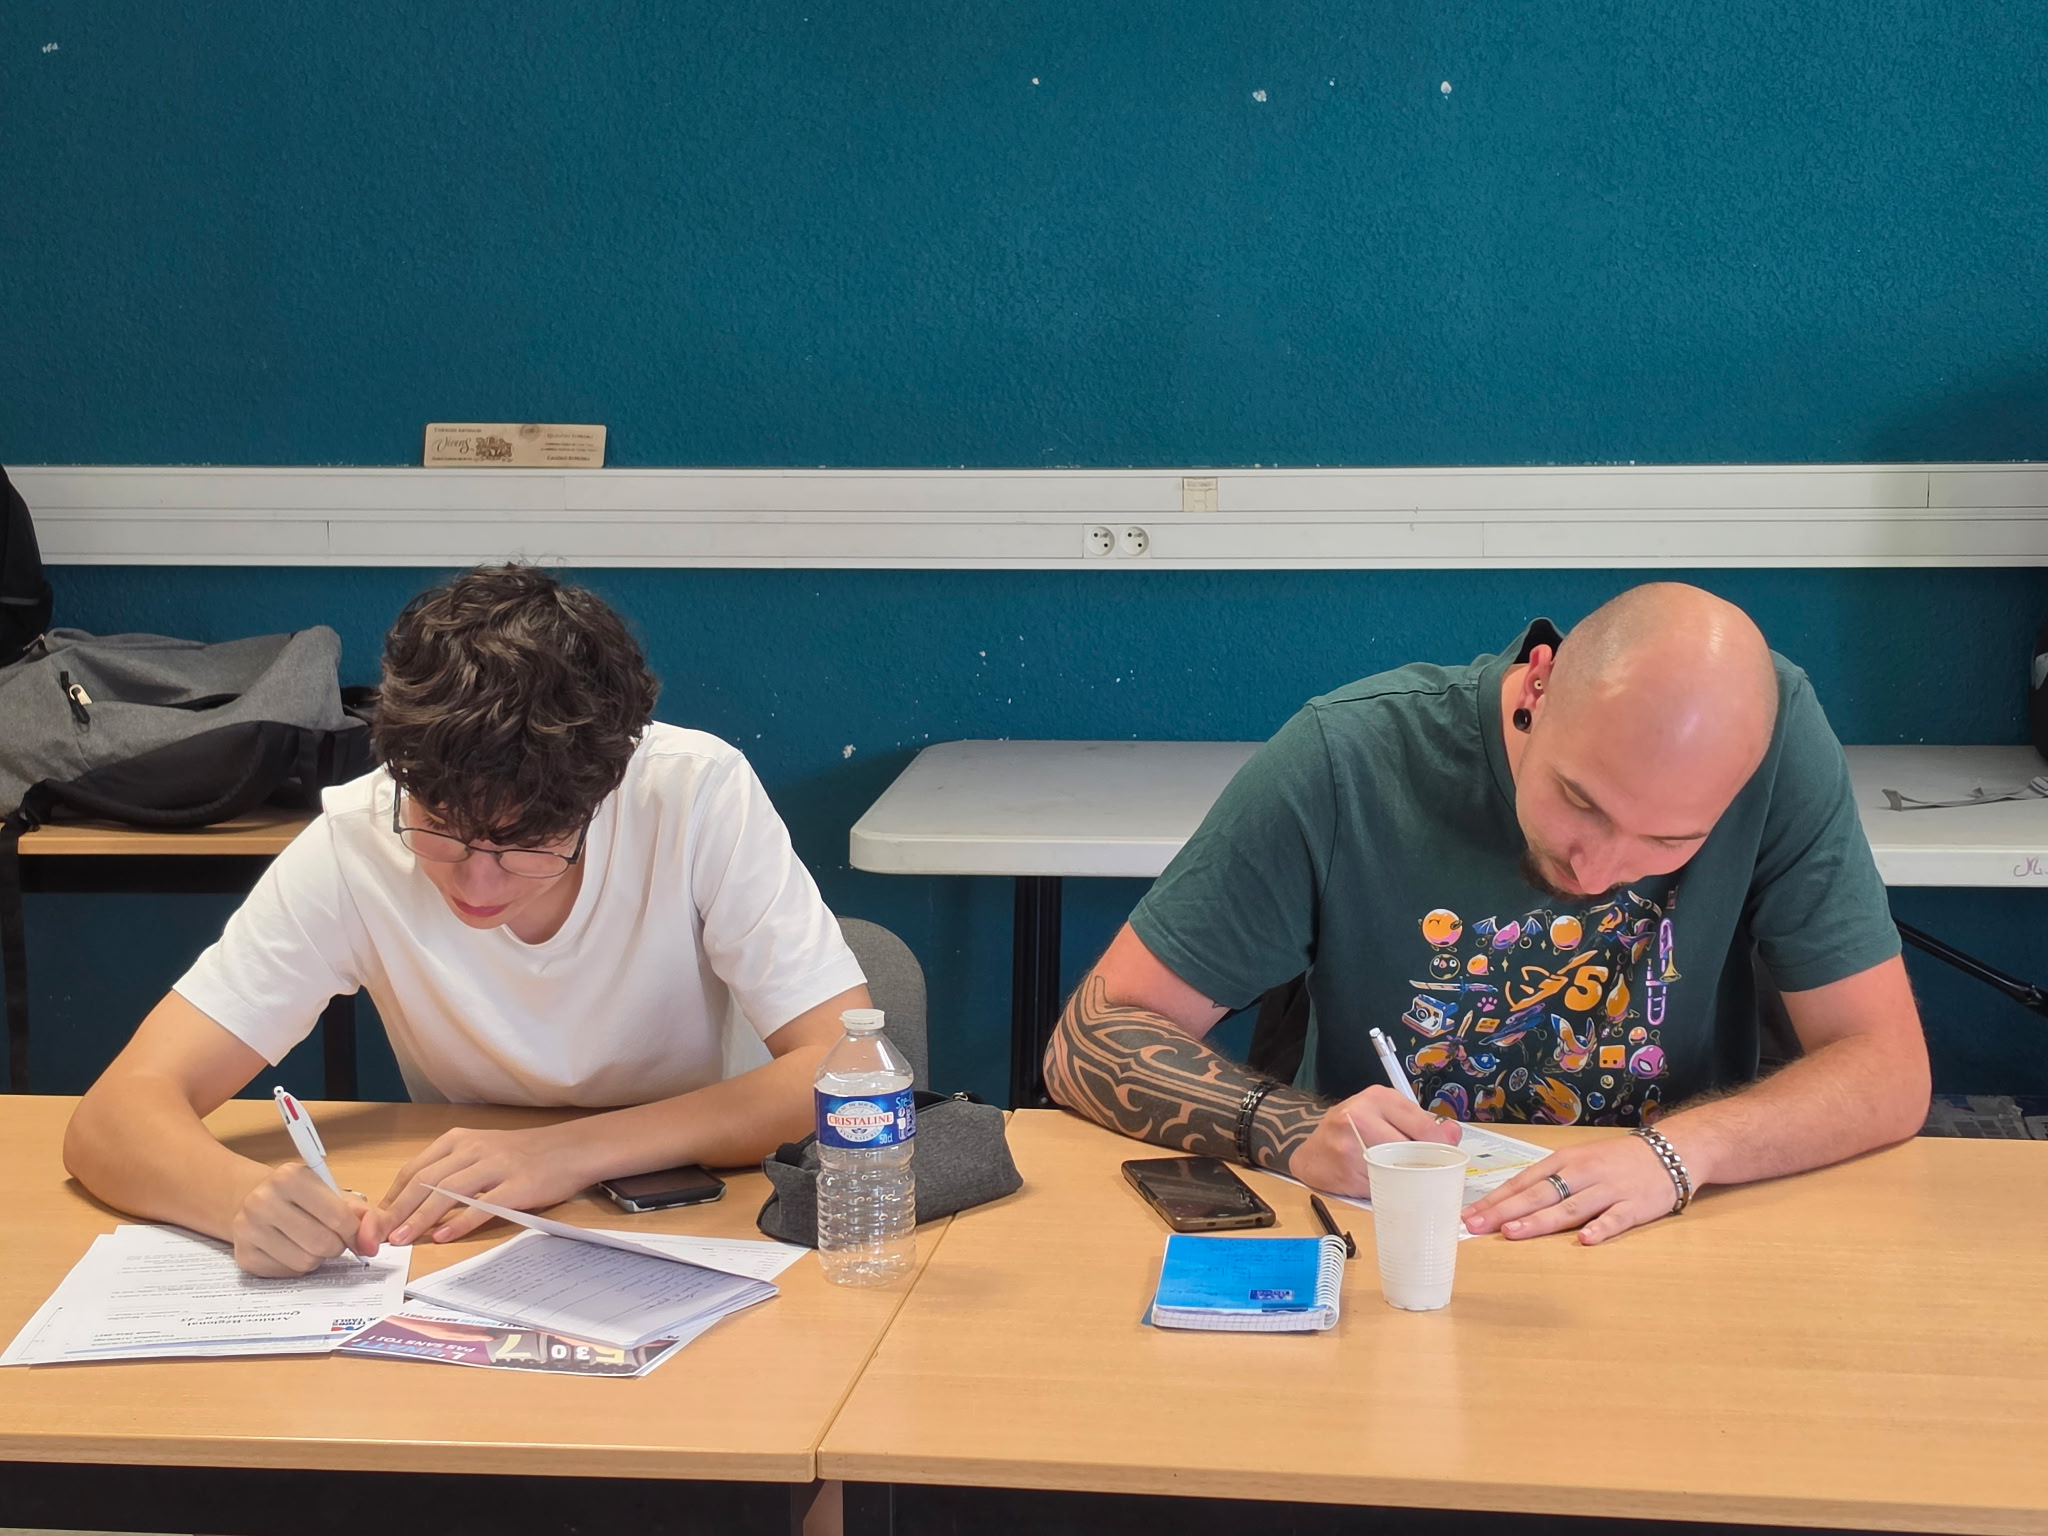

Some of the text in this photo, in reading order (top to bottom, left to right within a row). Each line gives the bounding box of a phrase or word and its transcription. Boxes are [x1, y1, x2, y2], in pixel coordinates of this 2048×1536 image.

[828, 1114, 892, 1126] CRISTALINE
[404, 1339, 444, 1348] SANS
[445, 1344, 476, 1353] PAS
[494, 1334, 533, 1358] 7
[550, 1344, 568, 1358] 0
[576, 1346, 591, 1360] 3
